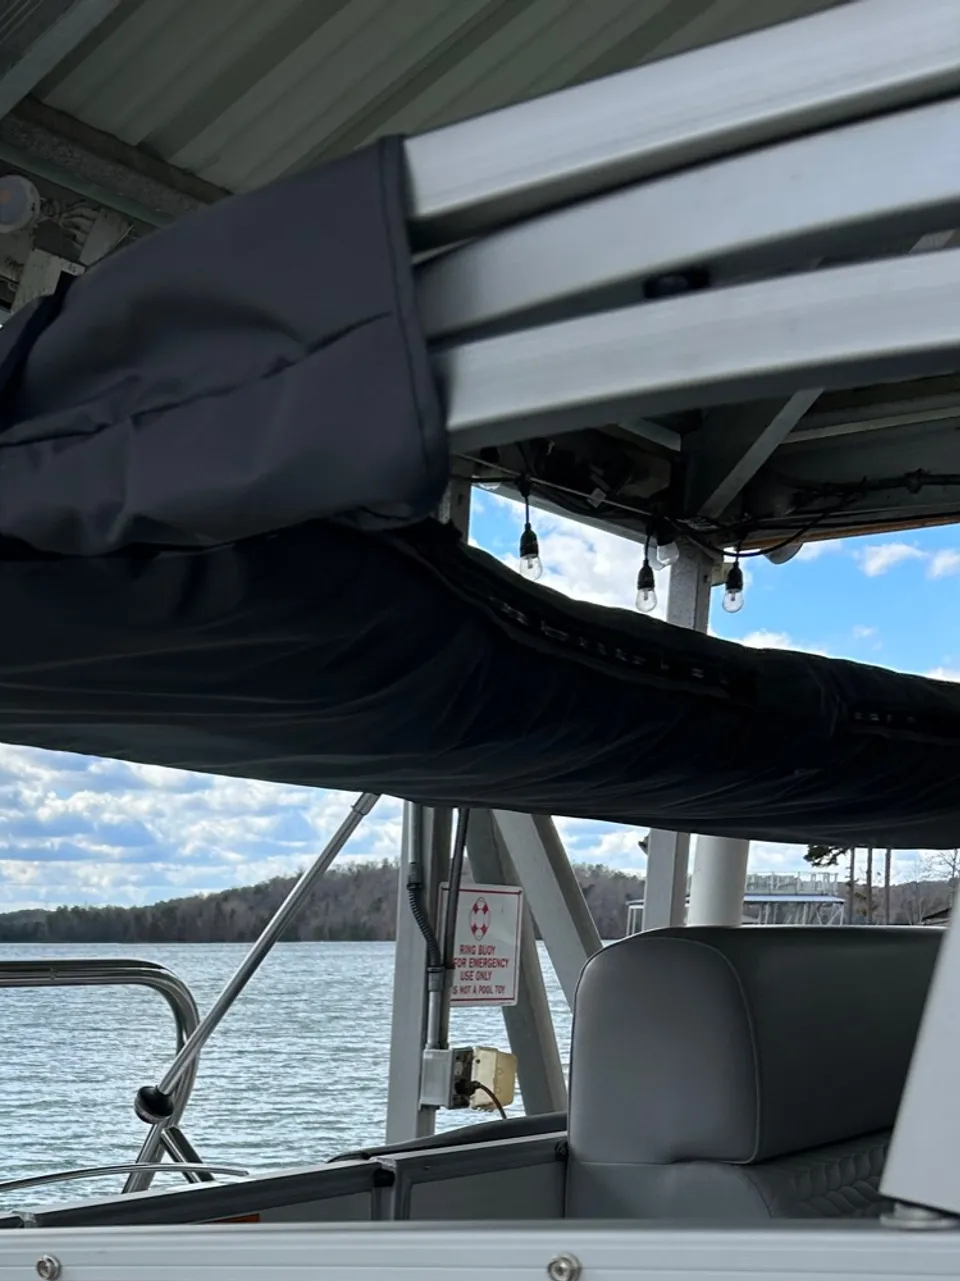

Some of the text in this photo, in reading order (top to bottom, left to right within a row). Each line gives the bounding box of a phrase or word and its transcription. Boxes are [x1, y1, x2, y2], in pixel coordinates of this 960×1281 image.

[460, 944, 496, 955] RING BUOY
[453, 957, 509, 968] FOR EMERGENCY
[460, 970, 492, 981] USE ONLY
[460, 984, 472, 994] NOT
[473, 984, 477, 994] A
[479, 984, 493, 994] POOL
[495, 984, 505, 994] TOY
